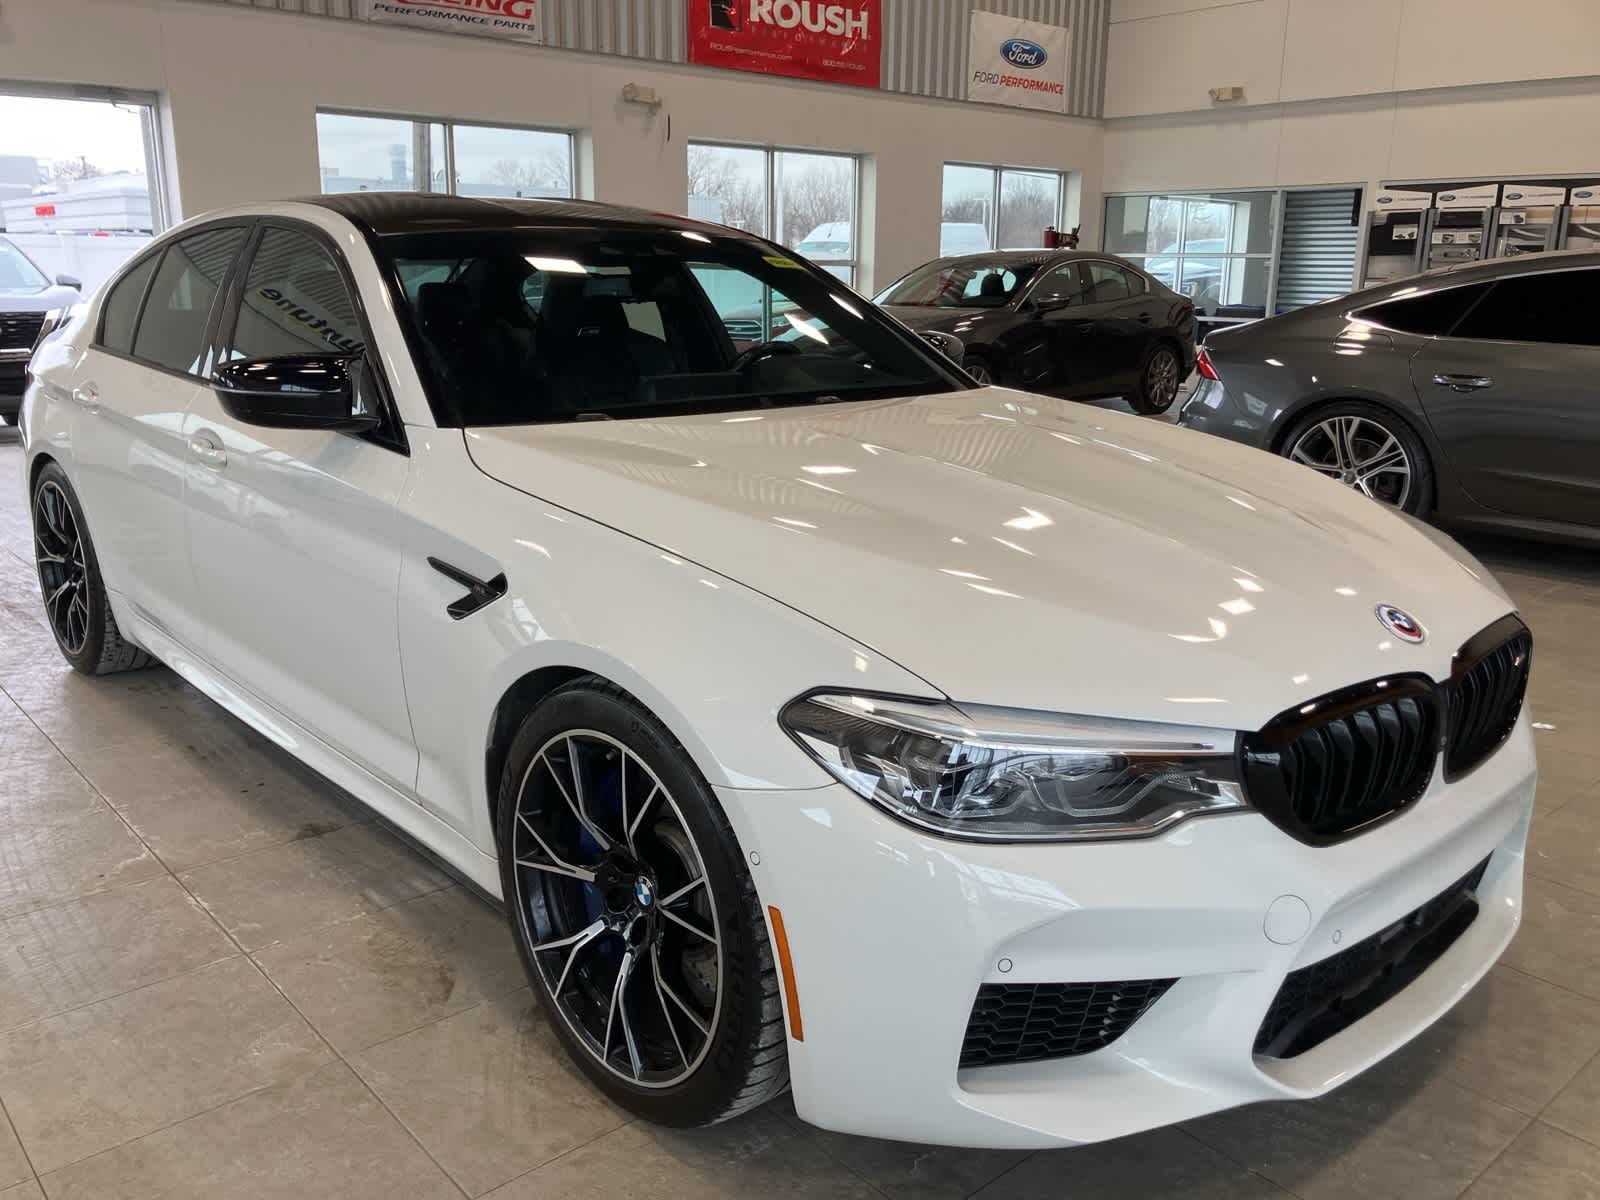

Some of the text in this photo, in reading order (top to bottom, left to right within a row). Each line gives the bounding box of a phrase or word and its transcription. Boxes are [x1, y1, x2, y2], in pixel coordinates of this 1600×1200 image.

[374, 3, 535, 31] PERFORMANCE PARTS
[750, 0, 869, 40] ROUSH
[1009, 42, 1038, 64] Ford
[973, 71, 1064, 95] FORD PERFORMANCE
